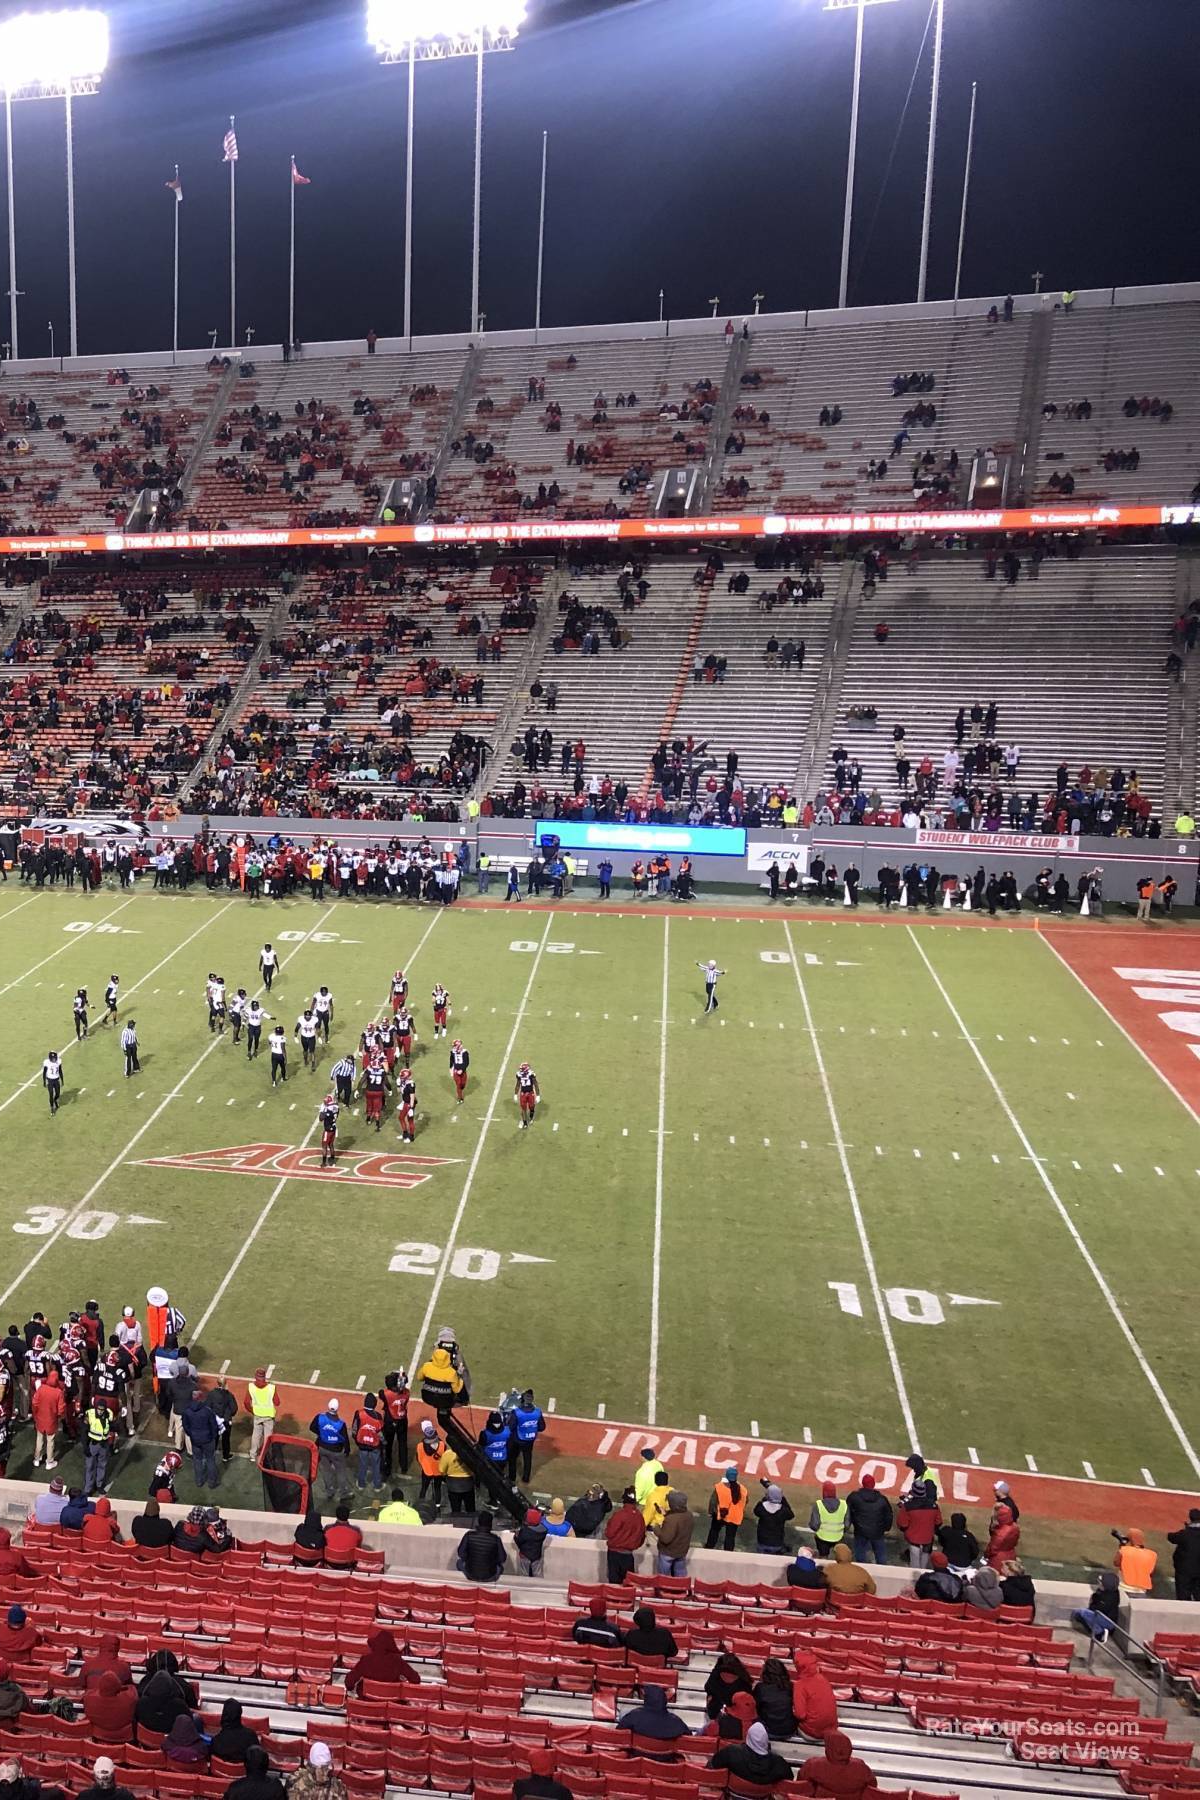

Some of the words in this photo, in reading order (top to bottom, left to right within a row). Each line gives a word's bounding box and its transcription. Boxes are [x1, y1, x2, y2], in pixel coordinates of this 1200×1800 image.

[436, 528, 467, 538] THINK
[468, 527, 492, 538] AND
[494, 527, 508, 537] DO
[510, 526, 530, 537] THE
[532, 524, 620, 536] EXTRAORDINARY
[125, 537, 152, 547] THINK
[154, 536, 174, 547] AND
[176, 535, 190, 546] DO
[191, 535, 209, 546] THE
[211, 533, 289, 545] EXTRAORDINARY
[792, 833, 799, 842] 7
[919, 832, 966, 844] STUDENT
[968, 834, 1027, 847] WOLFPACK
[1029, 837, 1059, 848] CLUB
[759, 850, 801, 861] ACCN
[1178, 845, 1188, 854] 8
[62, 921, 122, 933] 40
[275, 930, 338, 942] 30
[509, 940, 575, 954] 20
[760, 951, 824, 965] 10
[125, 1143, 467, 1188] ACC
[10, 1206, 119, 1240] 30
[387, 1241, 500, 1281] 20
[827, 1280, 945, 1325] 10
[99, 1378, 115, 1391] 95
